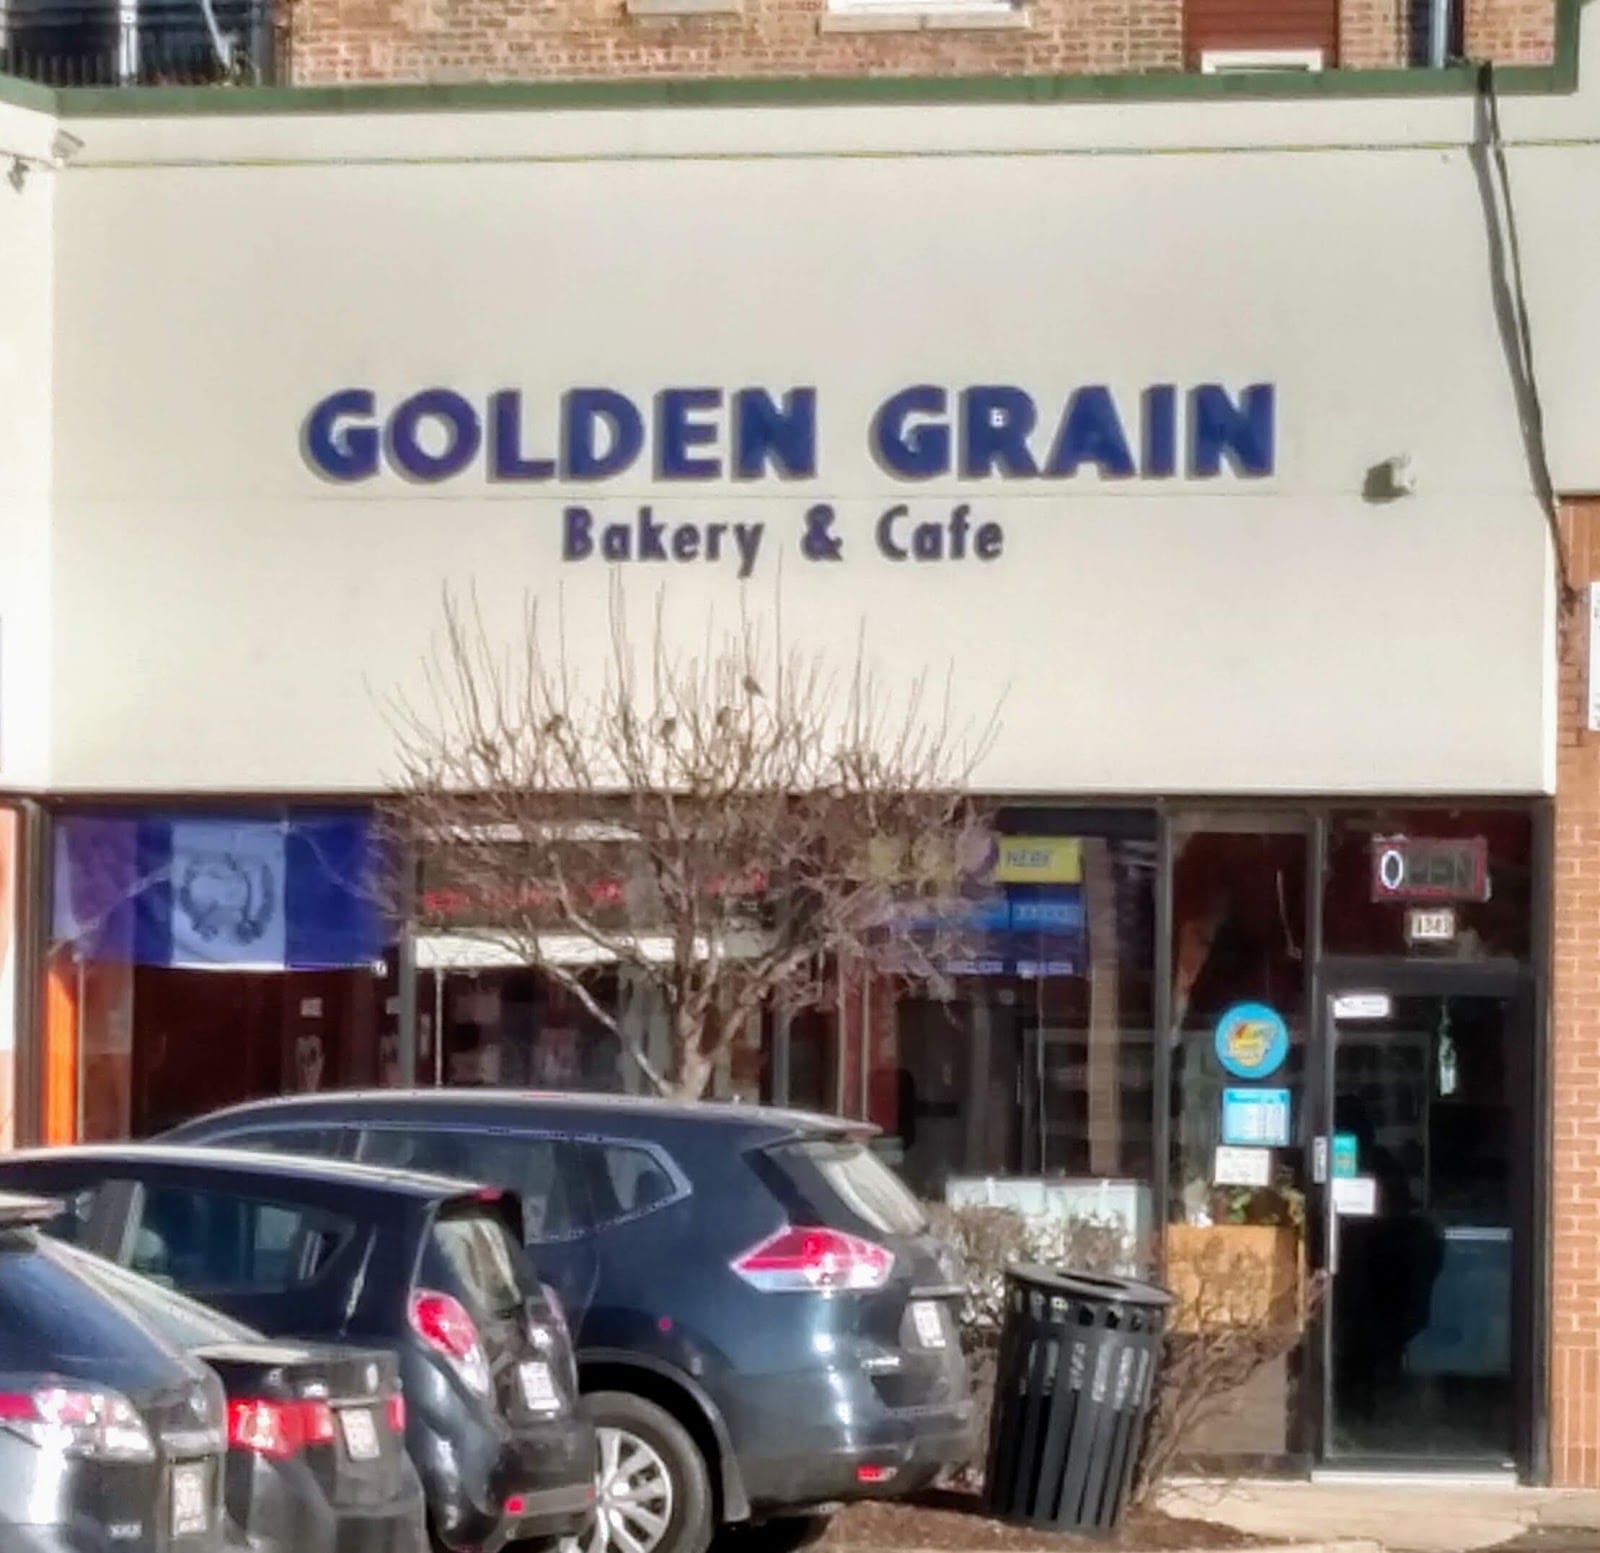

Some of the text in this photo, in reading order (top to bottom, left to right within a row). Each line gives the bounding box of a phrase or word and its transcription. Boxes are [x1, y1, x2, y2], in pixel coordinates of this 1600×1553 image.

[300, 383, 1277, 483] GOLDEN GRAIN
[562, 503, 1004, 578] Bakery & Cafe
